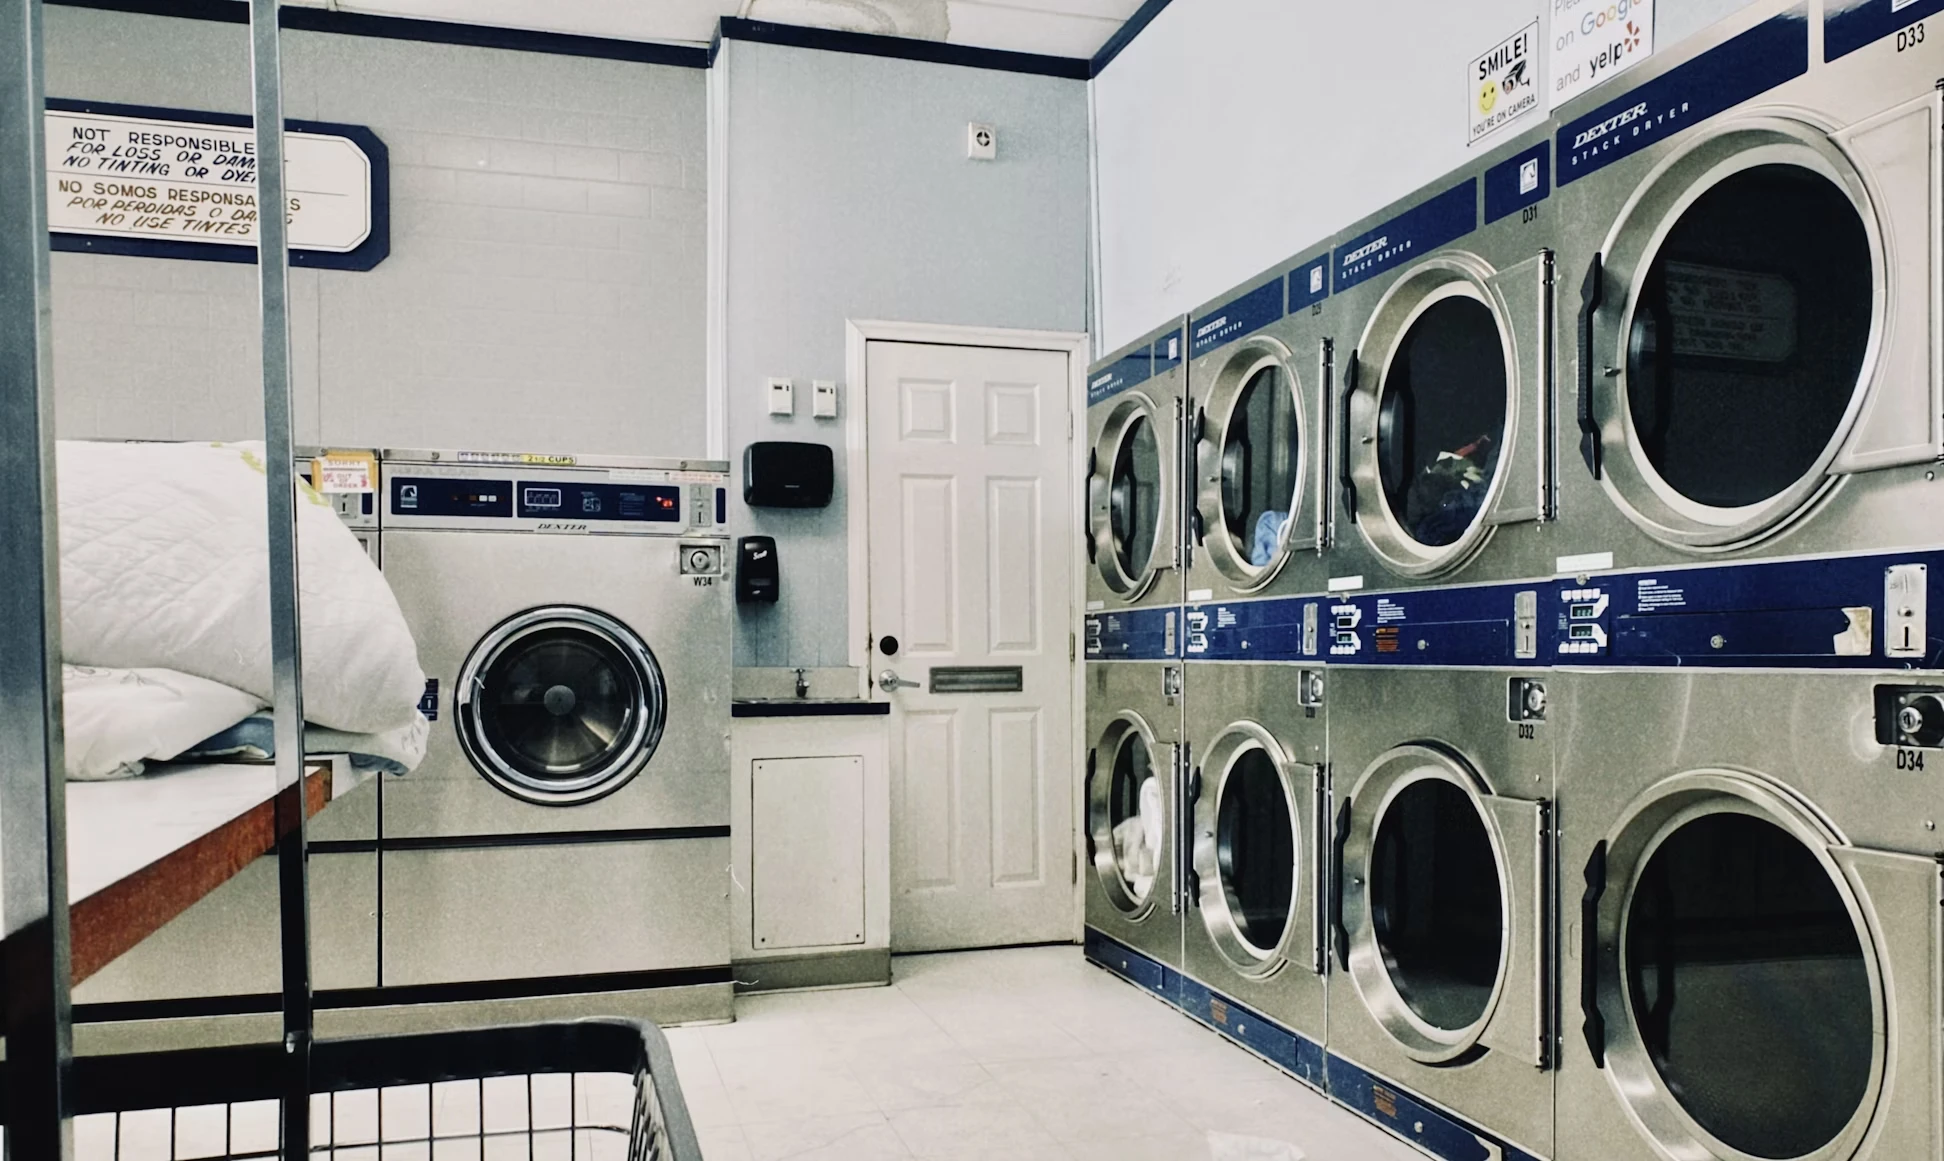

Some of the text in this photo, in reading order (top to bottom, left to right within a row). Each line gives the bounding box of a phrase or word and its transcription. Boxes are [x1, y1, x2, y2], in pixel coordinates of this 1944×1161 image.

[1556, 30, 1574, 51] on
[1897, 22, 1925, 53] D33
[1479, 33, 1527, 80] SMILE!
[1556, 42, 1623, 91] and yelp
[1472, 94, 1535, 136] YOU'RE ON CAMERA
[1572, 101, 1648, 149] DEXTER
[73, 127, 255, 155] NOT RESPONSIBLE
[1572, 102, 1689, 165] STACK DRYER
[67, 141, 106, 155] FOR
[112, 145, 161, 161] LOSS
[176, 151, 202, 165] OR
[62, 155, 91, 168] NO
[98, 157, 171, 176] TINTING
[185, 166, 209, 179] OR
[59, 179, 83, 193] NO
[93, 182, 157, 199] SOMOS
[67, 196, 108, 210] POR
[111, 200, 197, 217] PERDIDAS
[209, 207, 222, 218] O
[1522, 204, 1538, 224] D31
[96, 213, 252, 235] NO USE TINTES
[1342, 236, 1388, 266] DEXTER
[1342, 259, 1372, 279] STACK
[693, 576, 712, 586] W34
[1519, 723, 1534, 739] D32
[1896, 750, 1924, 771] D34
